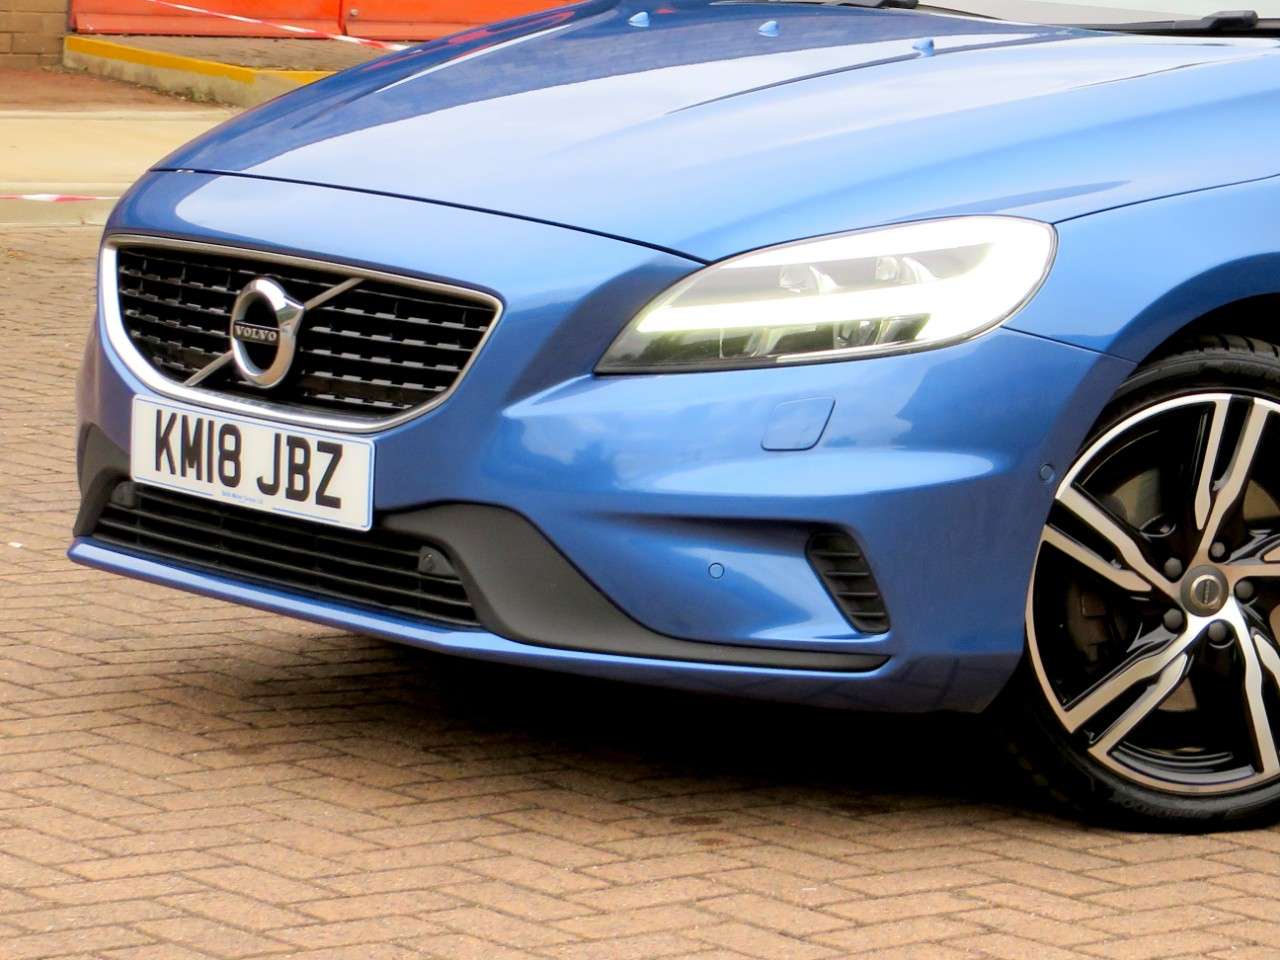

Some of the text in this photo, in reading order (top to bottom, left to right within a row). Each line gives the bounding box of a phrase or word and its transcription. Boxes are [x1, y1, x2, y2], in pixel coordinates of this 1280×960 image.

[234, 325, 277, 341] VOLVO
[155, 409, 343, 509] KM18 JBZ
